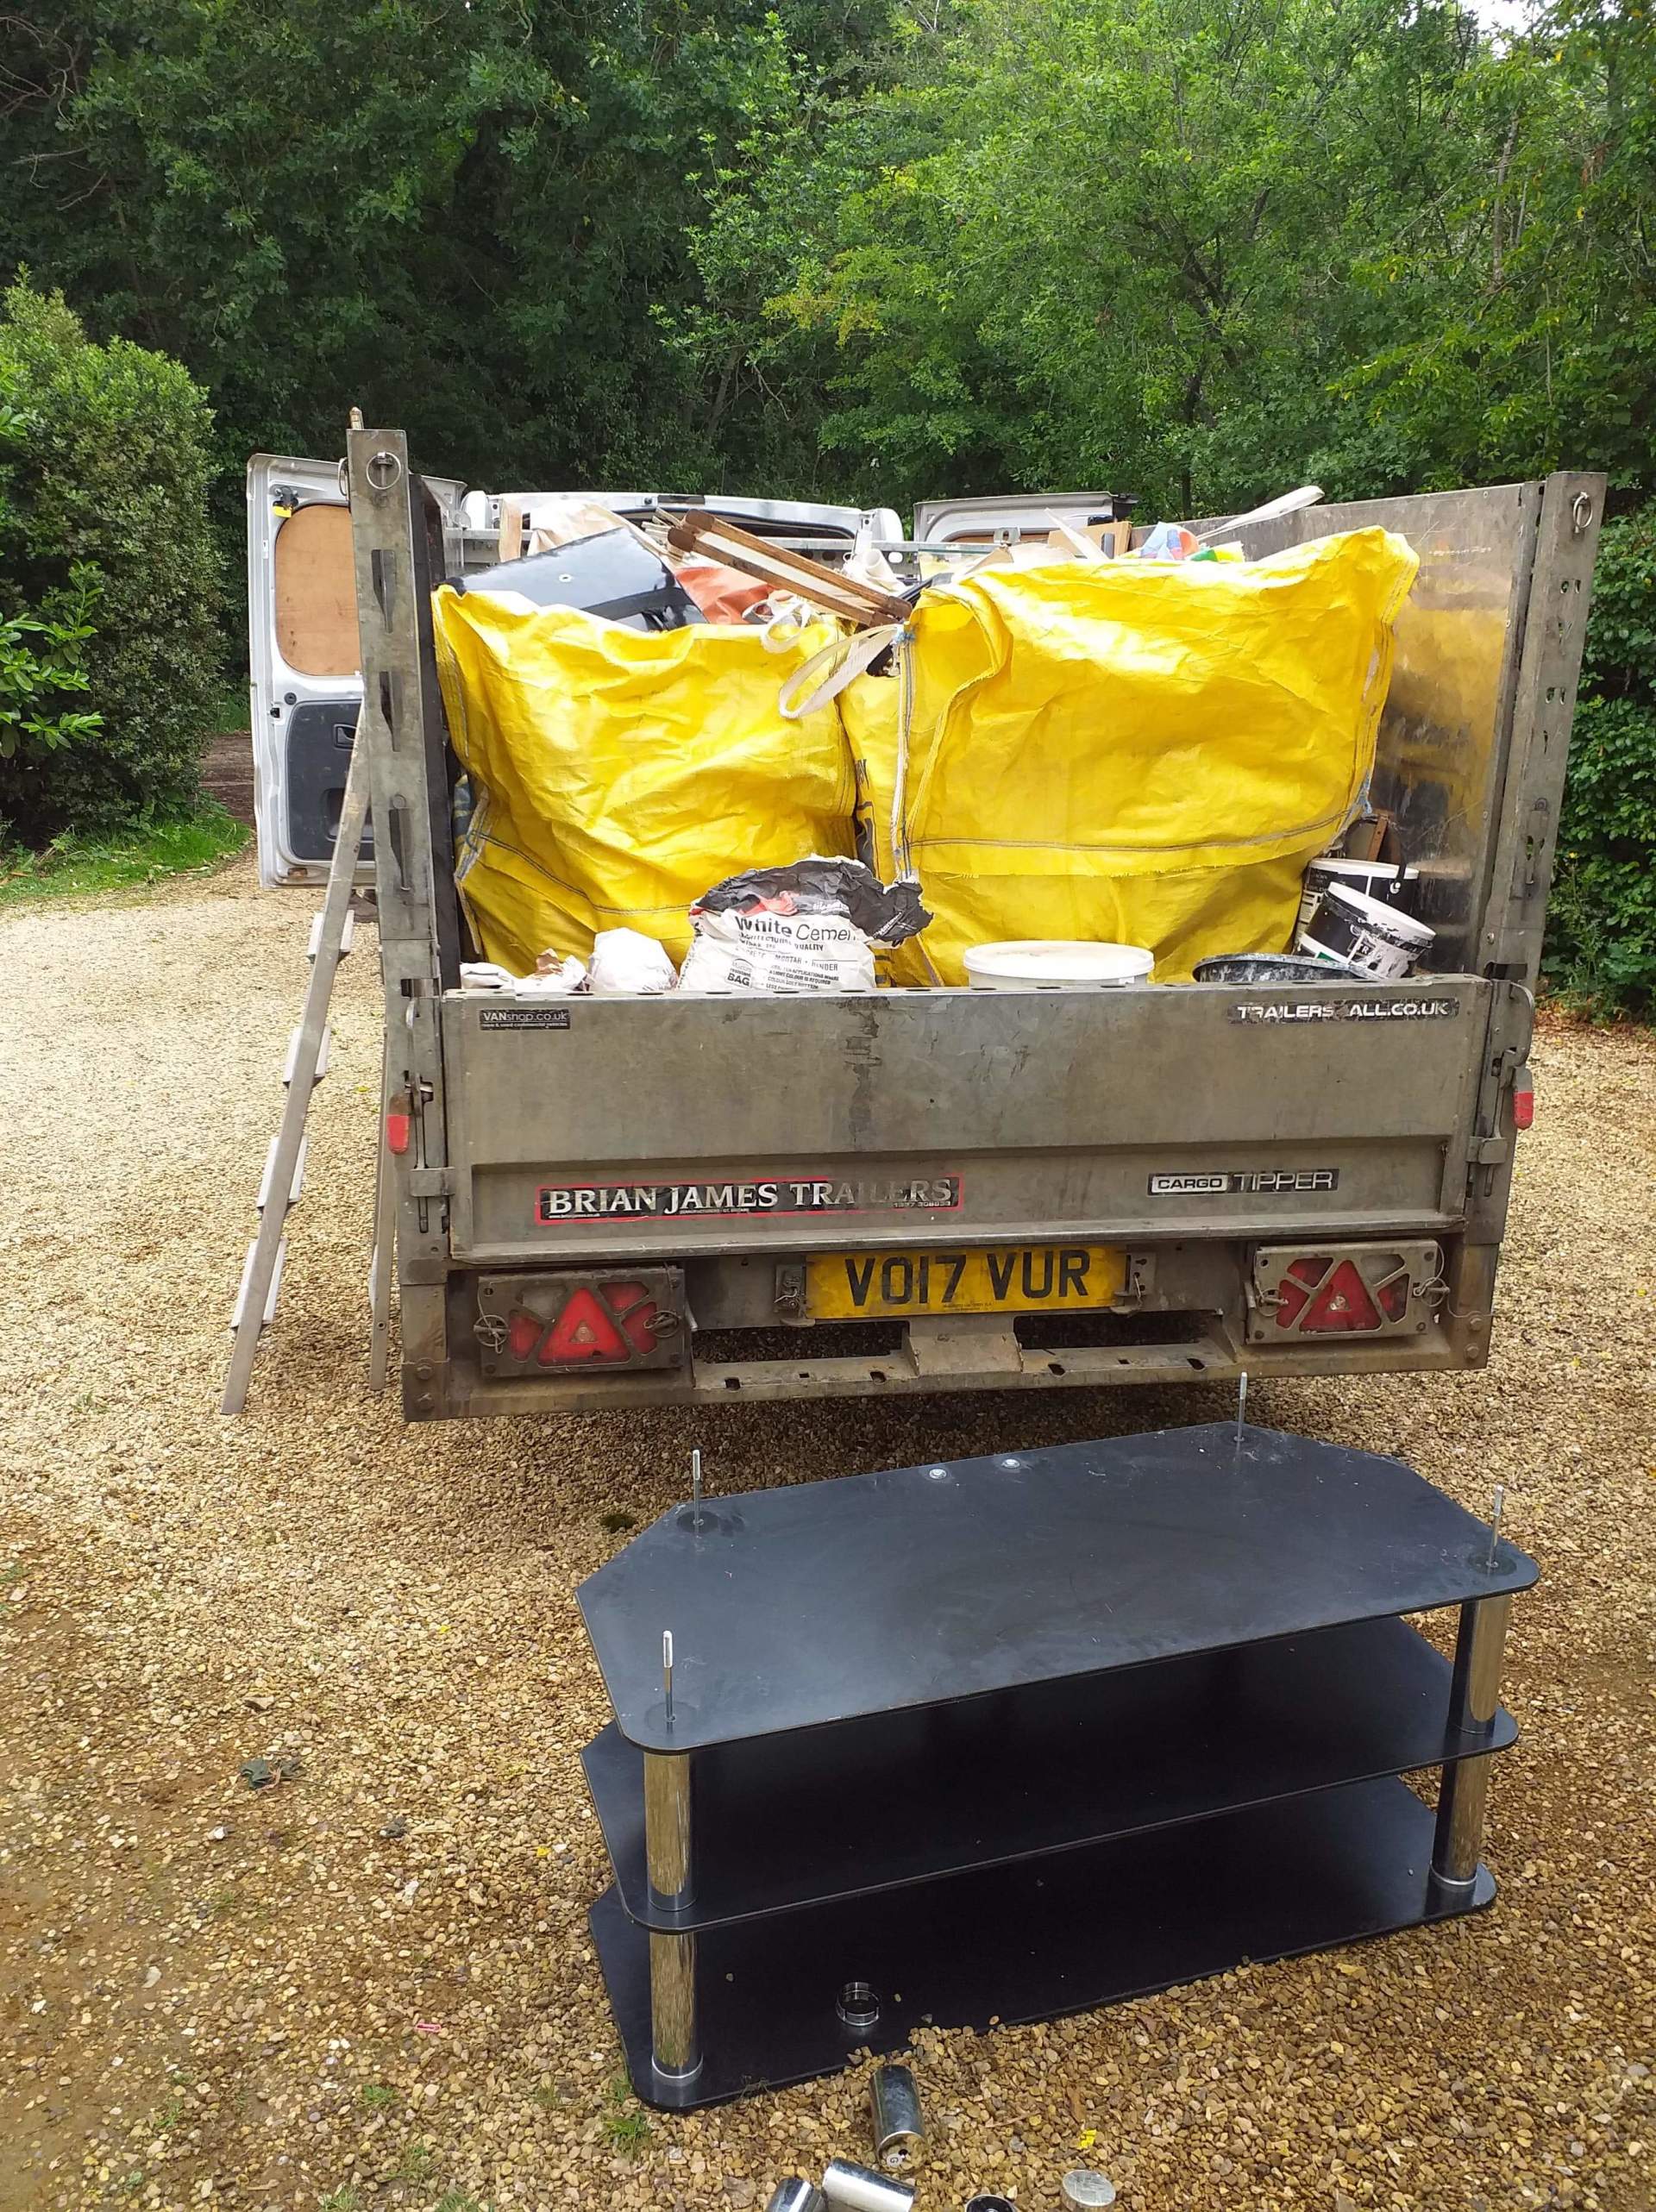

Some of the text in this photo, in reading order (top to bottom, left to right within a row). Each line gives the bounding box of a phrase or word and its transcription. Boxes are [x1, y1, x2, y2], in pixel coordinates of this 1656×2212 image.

[735, 915, 793, 937] White
[727, 973, 750, 987] BAG
[1157, 1172, 1333, 1191] CARGO TIPPER
[549, 1187, 657, 1215] BRIAN
[663, 1183, 778, 1215] JAMES
[844, 1250, 1092, 1307] VO17 VUR
